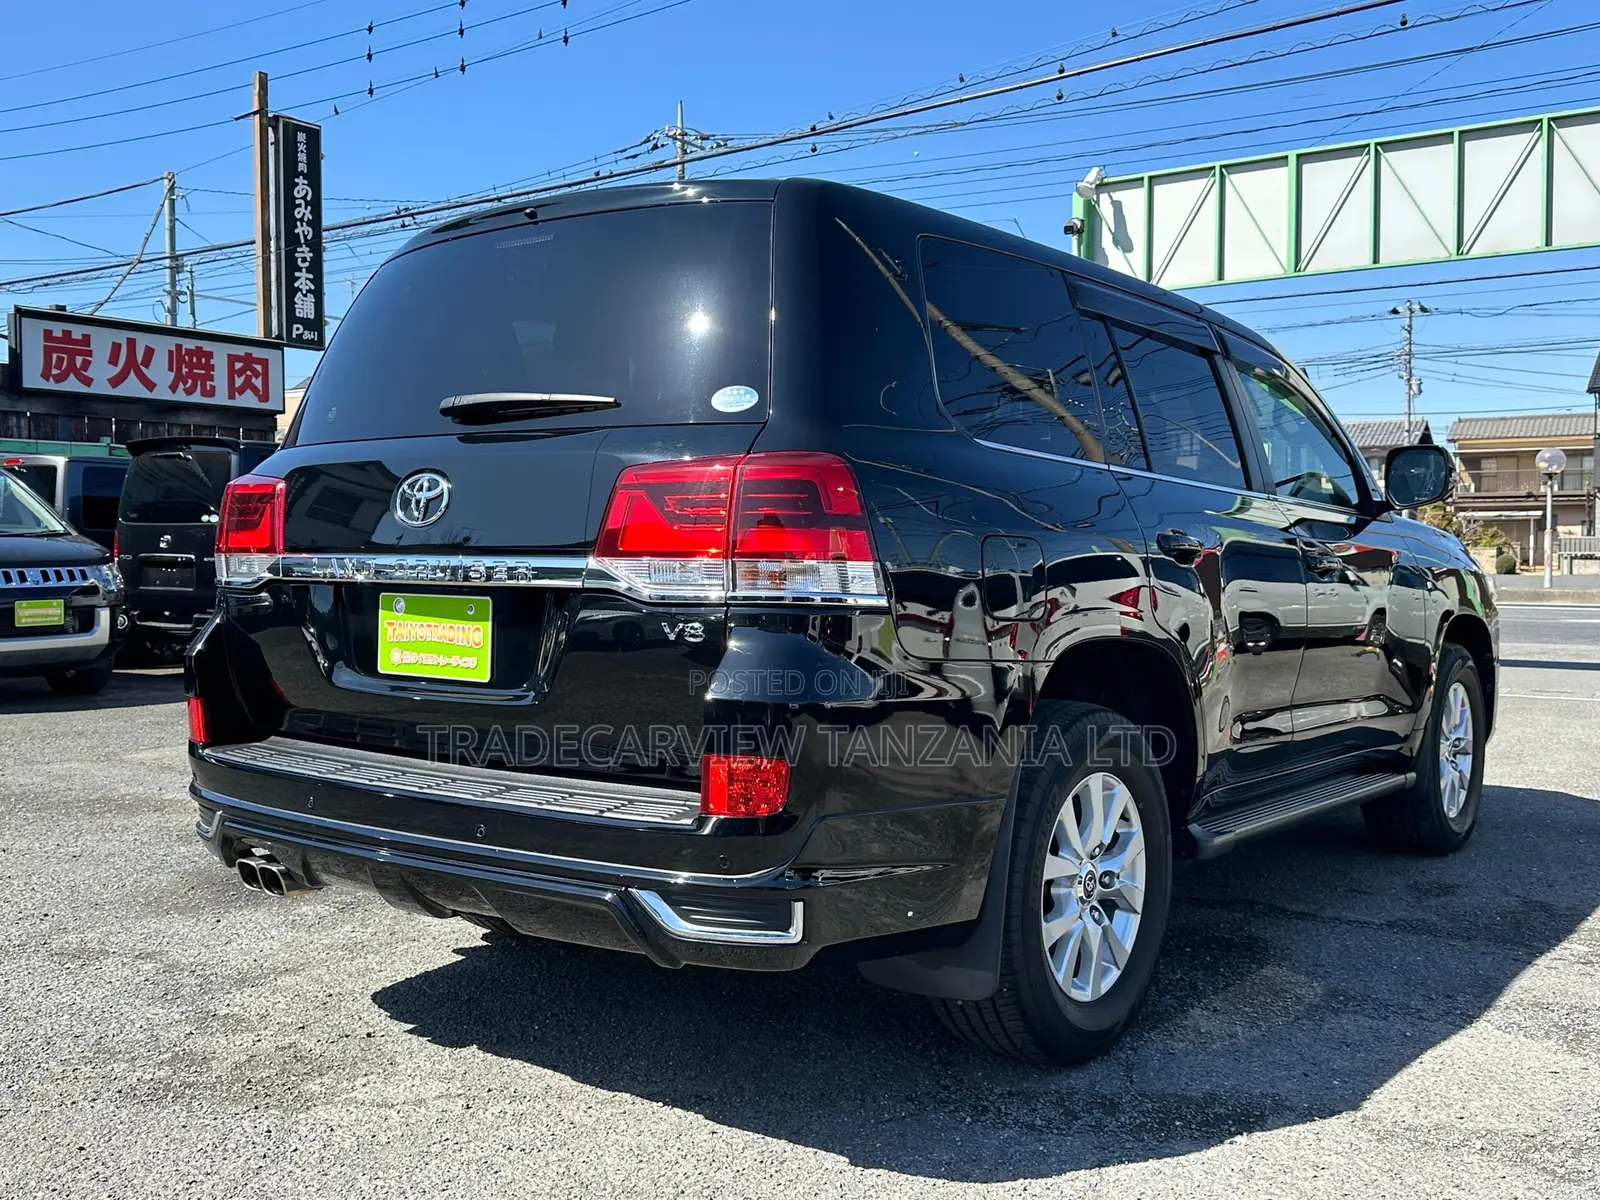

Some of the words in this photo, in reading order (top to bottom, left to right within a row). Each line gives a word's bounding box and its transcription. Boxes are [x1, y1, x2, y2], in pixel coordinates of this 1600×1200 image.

[296, 131, 308, 173] 炭火焼肉
[293, 175, 316, 320] あみやき本舗
[292, 323, 318, 341] Pあり
[40, 328, 270, 404] 炭火焼肉
[385, 620, 484, 648] TAIYOTRADING
[661, 621, 706, 643] V8
